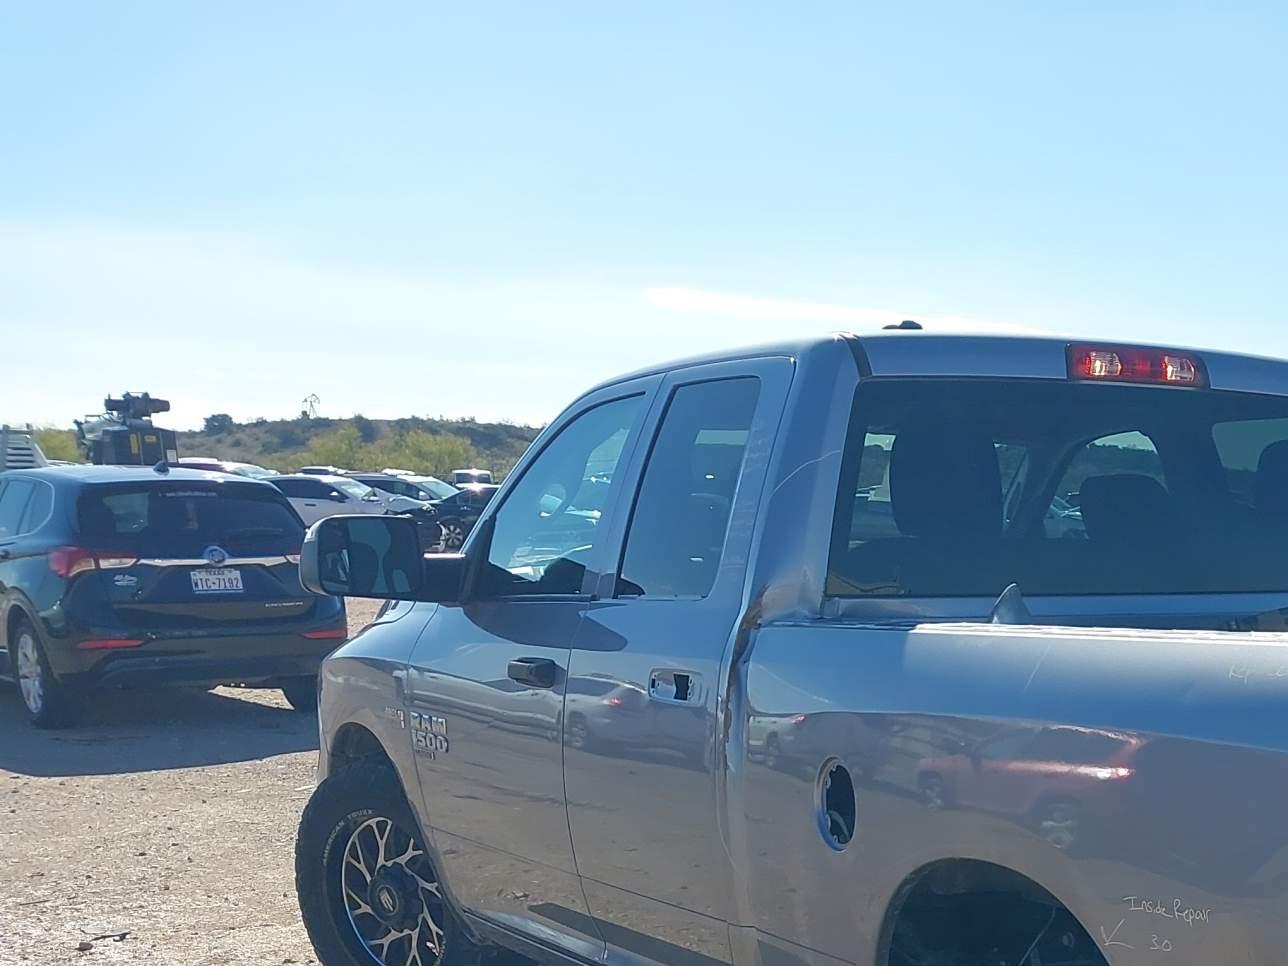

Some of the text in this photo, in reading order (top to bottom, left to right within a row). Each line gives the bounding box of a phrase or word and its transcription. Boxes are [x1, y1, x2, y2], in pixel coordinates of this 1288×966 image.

[410, 711, 447, 736] RAM
[411, 729, 448, 752] 1500
[1122, 896, 1213, 927] Inside Repair
[1149, 934, 1173, 952] 30
